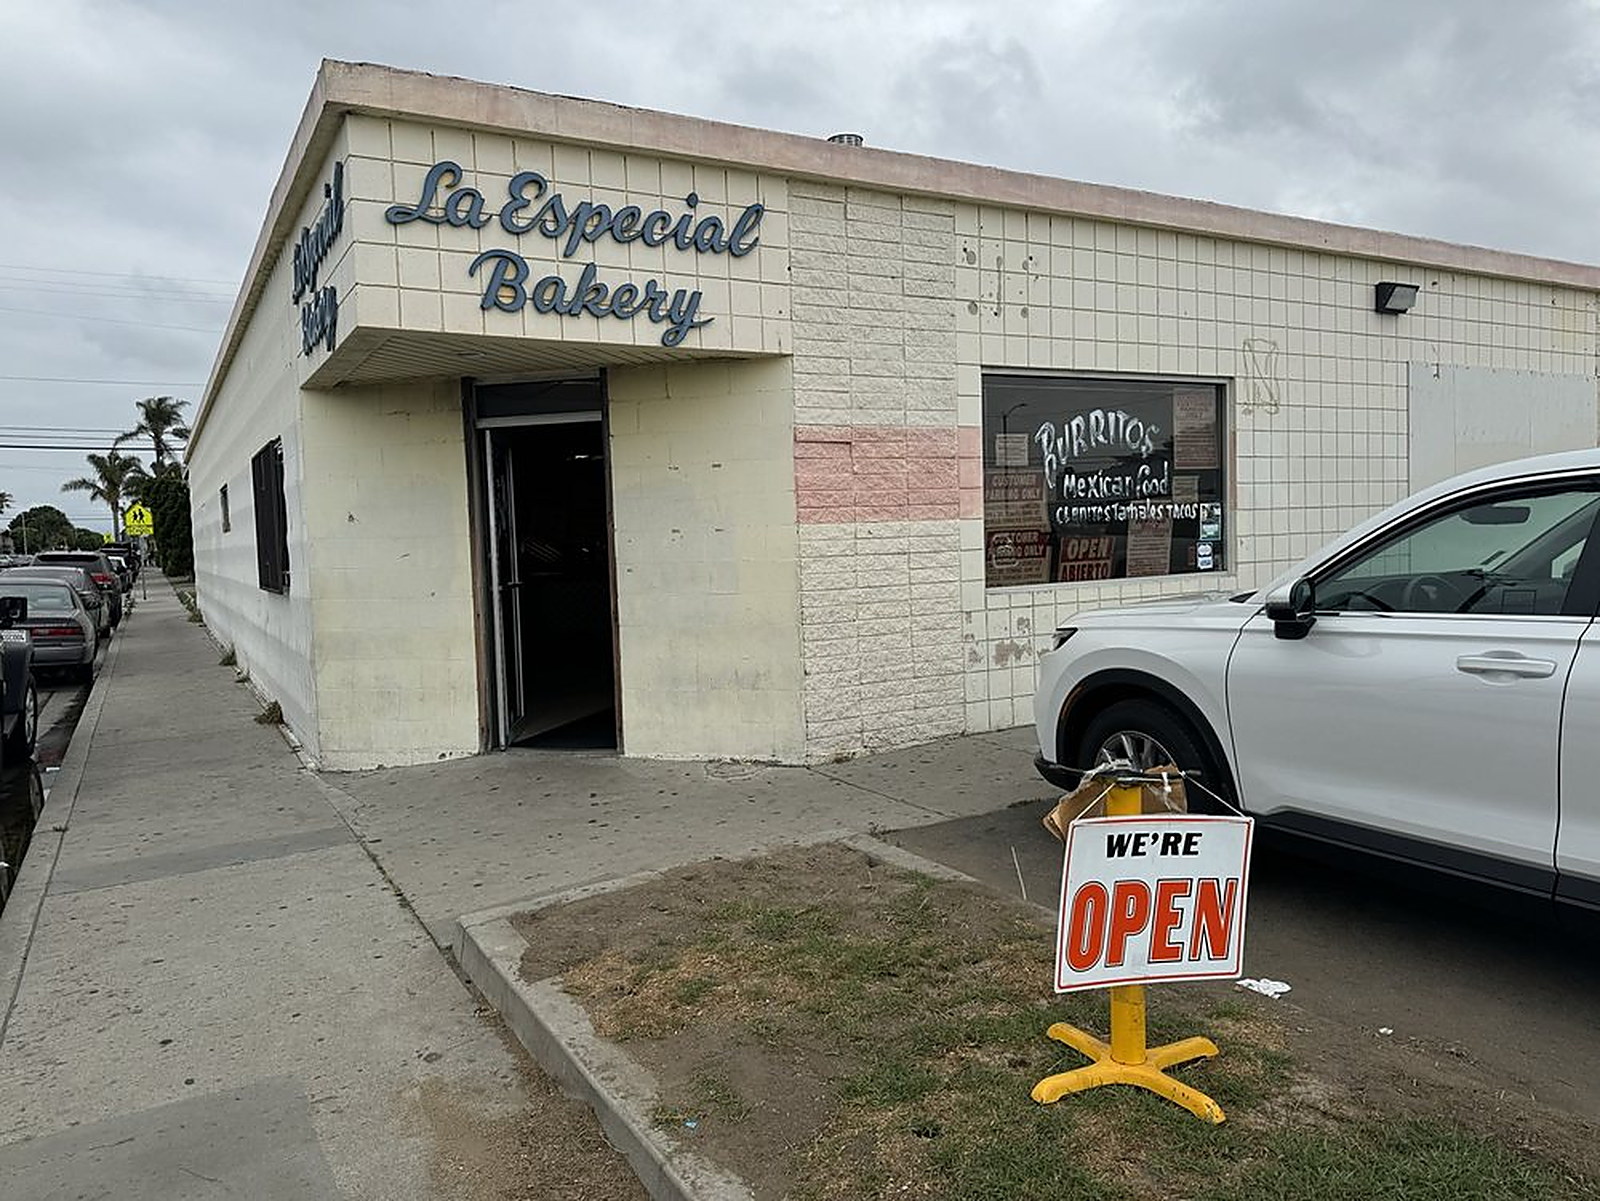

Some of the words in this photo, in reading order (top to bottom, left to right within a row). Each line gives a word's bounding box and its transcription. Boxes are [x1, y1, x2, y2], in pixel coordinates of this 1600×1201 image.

[384, 160, 493, 229] La
[499, 171, 765, 258] Especial
[468, 249, 716, 347] Bakery
[1034, 409, 1160, 489] BURRITOS
[1063, 469, 1134, 499] Mexican
[1061, 562, 1111, 580] ABIERTO
[1067, 537, 1110, 560] OPEN
[1105, 832, 1202, 858] WE'RE
[1065, 877, 1239, 972] OPEN
